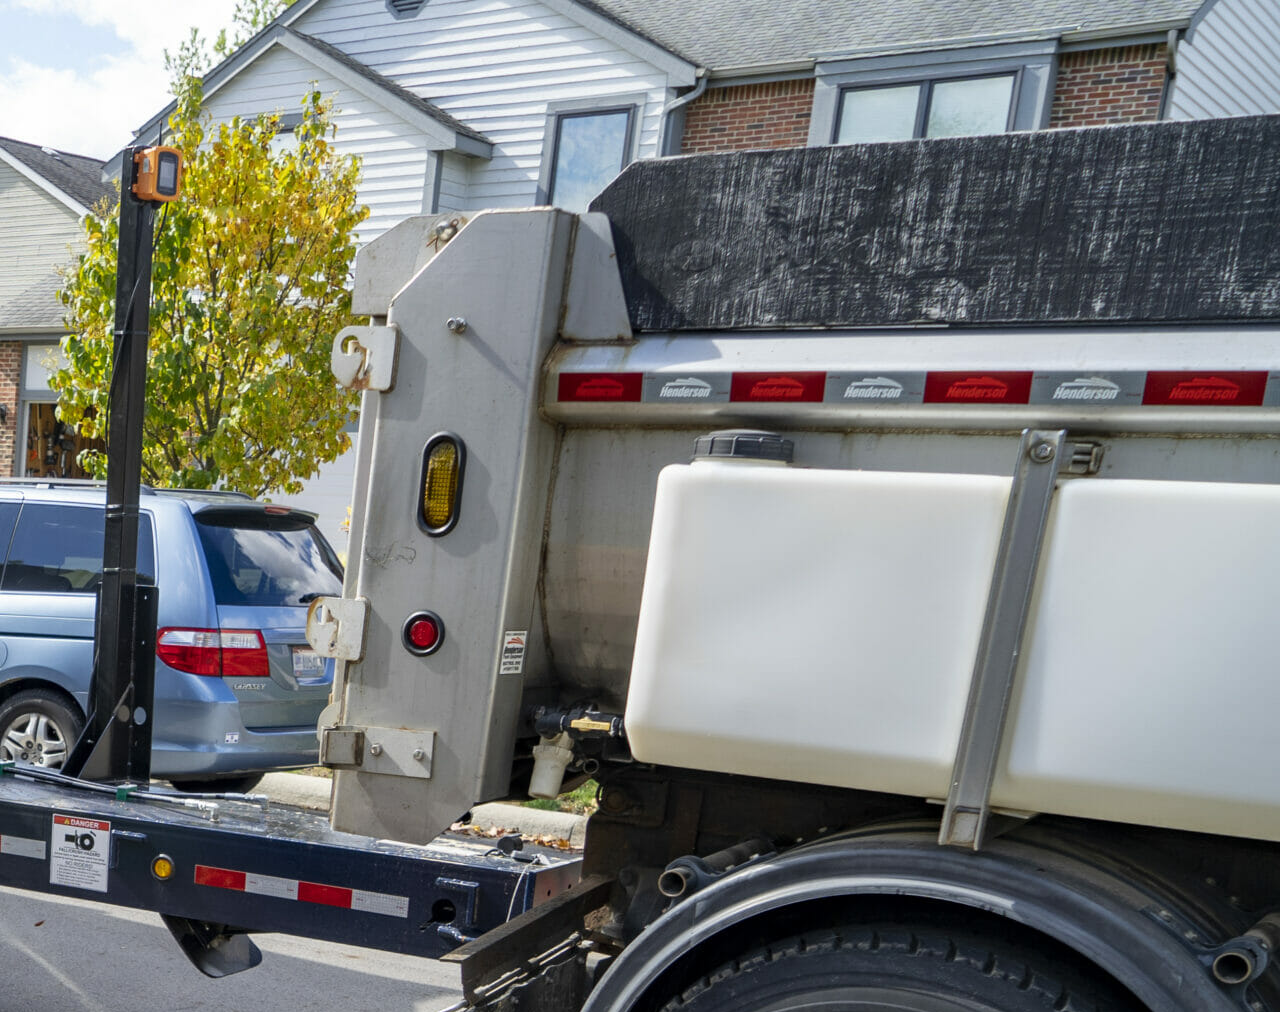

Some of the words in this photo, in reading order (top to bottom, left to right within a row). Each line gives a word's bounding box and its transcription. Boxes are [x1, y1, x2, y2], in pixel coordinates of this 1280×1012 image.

[660, 386, 712, 398] Henderson
[844, 386, 902, 399] Henderson
[946, 386, 1008, 399] Henderson
[1052, 386, 1119, 400] Henderson
[1169, 387, 1240, 400] Henderson
[70, 818, 100, 829] DANGER
